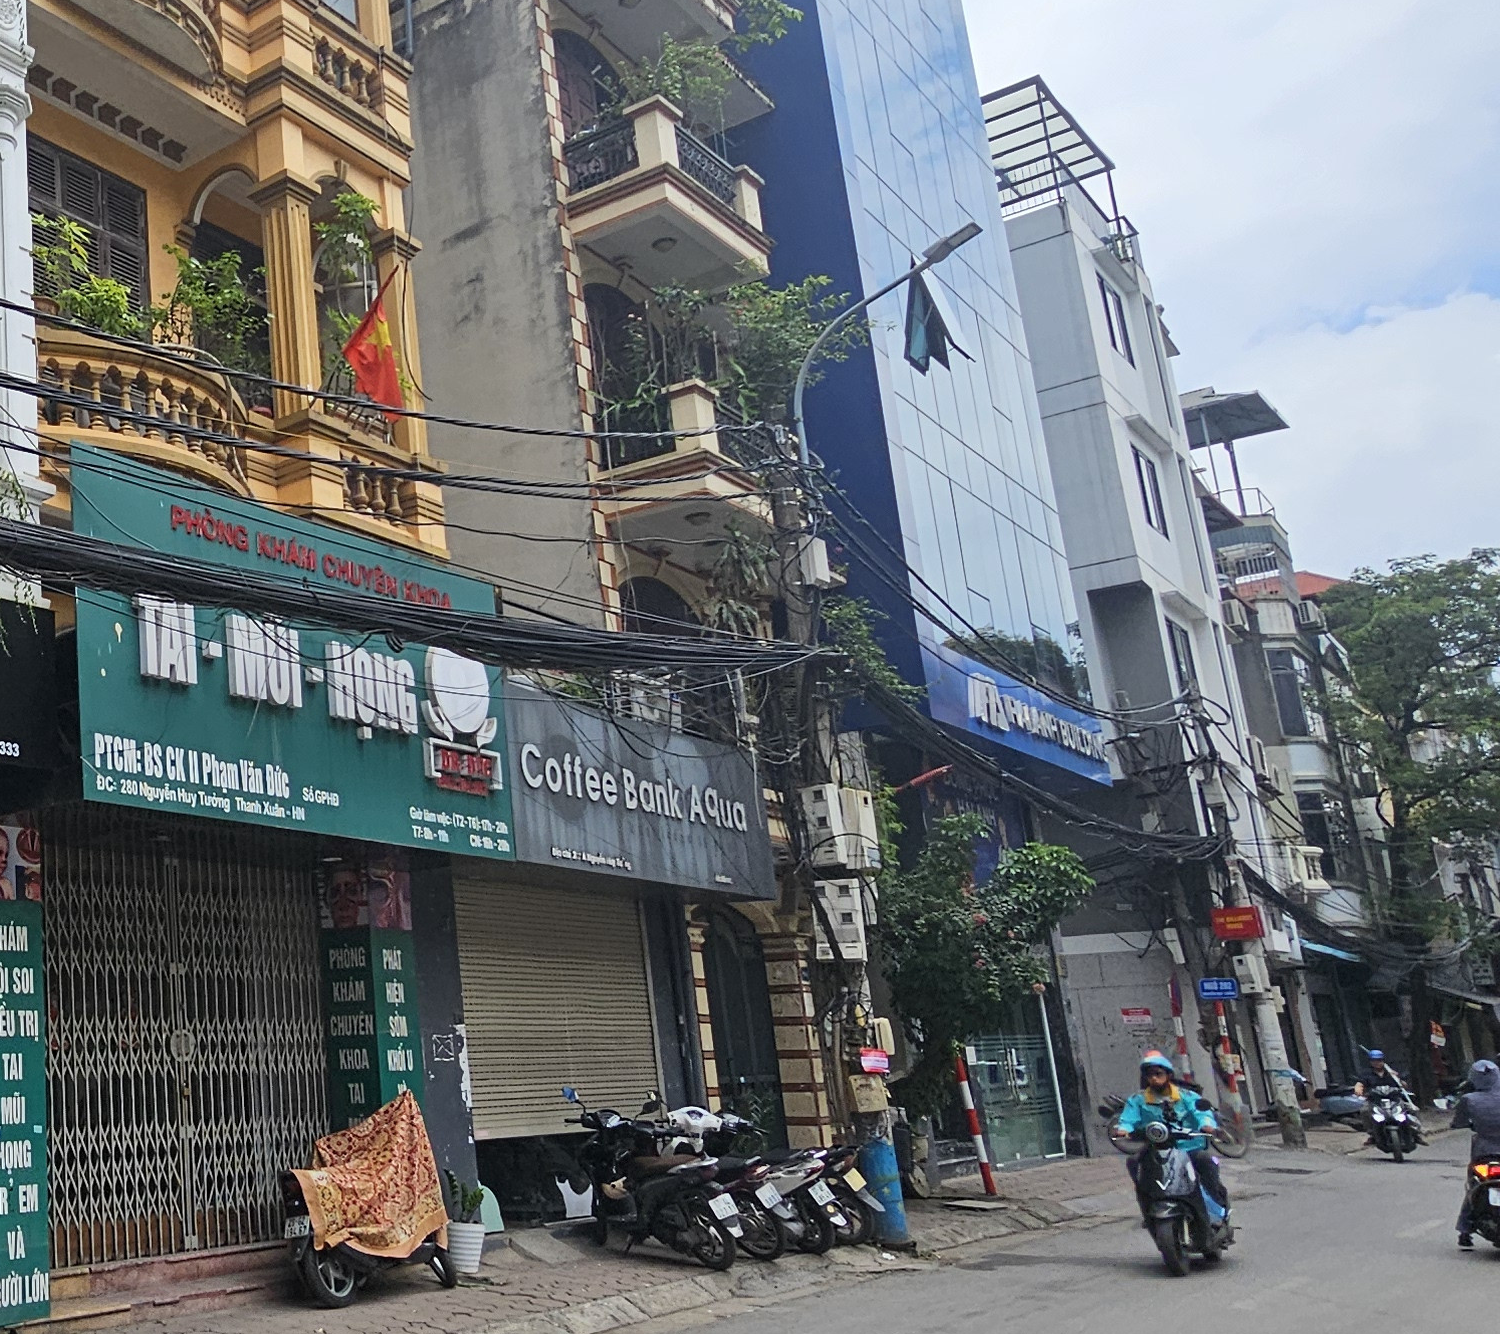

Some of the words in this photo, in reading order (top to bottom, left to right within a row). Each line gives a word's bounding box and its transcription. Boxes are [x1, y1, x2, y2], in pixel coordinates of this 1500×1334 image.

[171, 504, 248, 551] PHÒNG
[257, 533, 316, 572] KHÁM
[322, 553, 398, 598] CHUYÊN
[132, 592, 198, 685] TAI
[325, 641, 419, 741] HỌNG
[94, 732, 142, 774] PTCM:
[143, 742, 163, 778] BS
[166, 746, 186, 782] CK
[202, 752, 239, 793] Phạm
[239, 759, 264, 795] Văn
[265, 763, 290, 799] Đức
[120, 779, 138, 796] 280
[139, 781, 177, 802] Nguyễn
[177, 789, 197, 808] Huy
[235, 796, 262, 815] Thanh
[263, 801, 285, 818] Xuân
[291, 805, 305, 821] HN
[520, 743, 618, 806] Coffee
[622, 767, 682, 820] Bank
[689, 784, 748, 832] Aqua
[329, 943, 366, 970] PHÒNG
[382, 945, 402, 970] PHÁT
[12, 967, 34, 994] SOI
[333, 976, 366, 1002] KHÁM
[18, 1010, 39, 1042] TRỊ
[330, 1012, 374, 1037] CHUYÊN
[2, 1053, 23, 1080] TAI
[339, 1047, 370, 1071] KHOA
[1, 1092, 26, 1125] MŨI
[348, 1082, 365, 1105] TAI
[19, 1184, 39, 1214] EM
[7, 1225, 26, 1260] VÀ
[25, 1267, 49, 1303] LỚN
